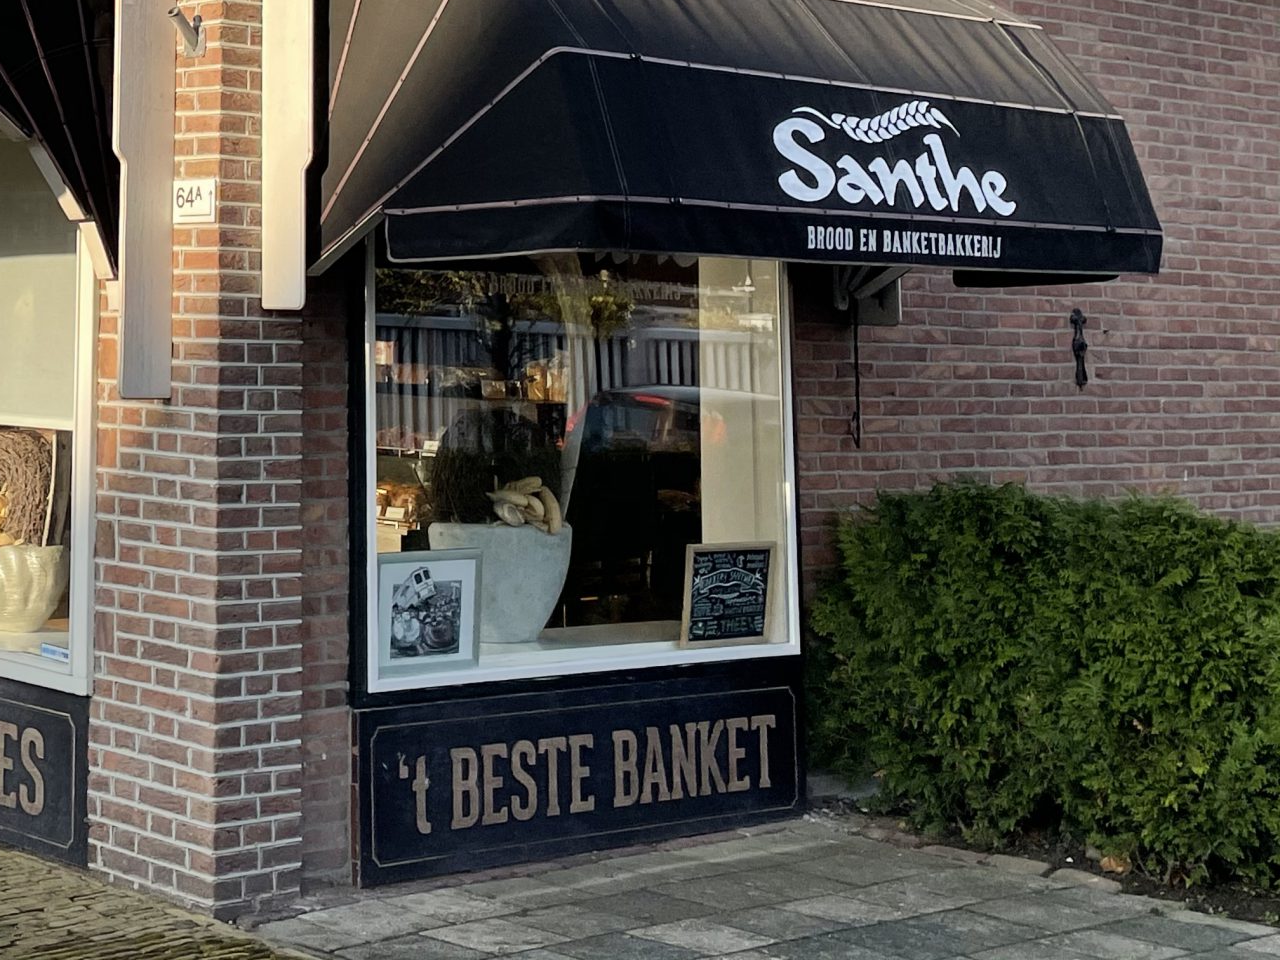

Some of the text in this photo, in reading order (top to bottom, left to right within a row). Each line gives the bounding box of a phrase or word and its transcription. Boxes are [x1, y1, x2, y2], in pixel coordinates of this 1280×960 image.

[176, 186, 202, 208] 64A
[773, 117, 1017, 217] Santhe
[807, 226, 1002, 259] BROOD EN BANKETBAKKERIJ
[450, 734, 595, 830] BESTE
[612, 714, 776, 808] BANKET
